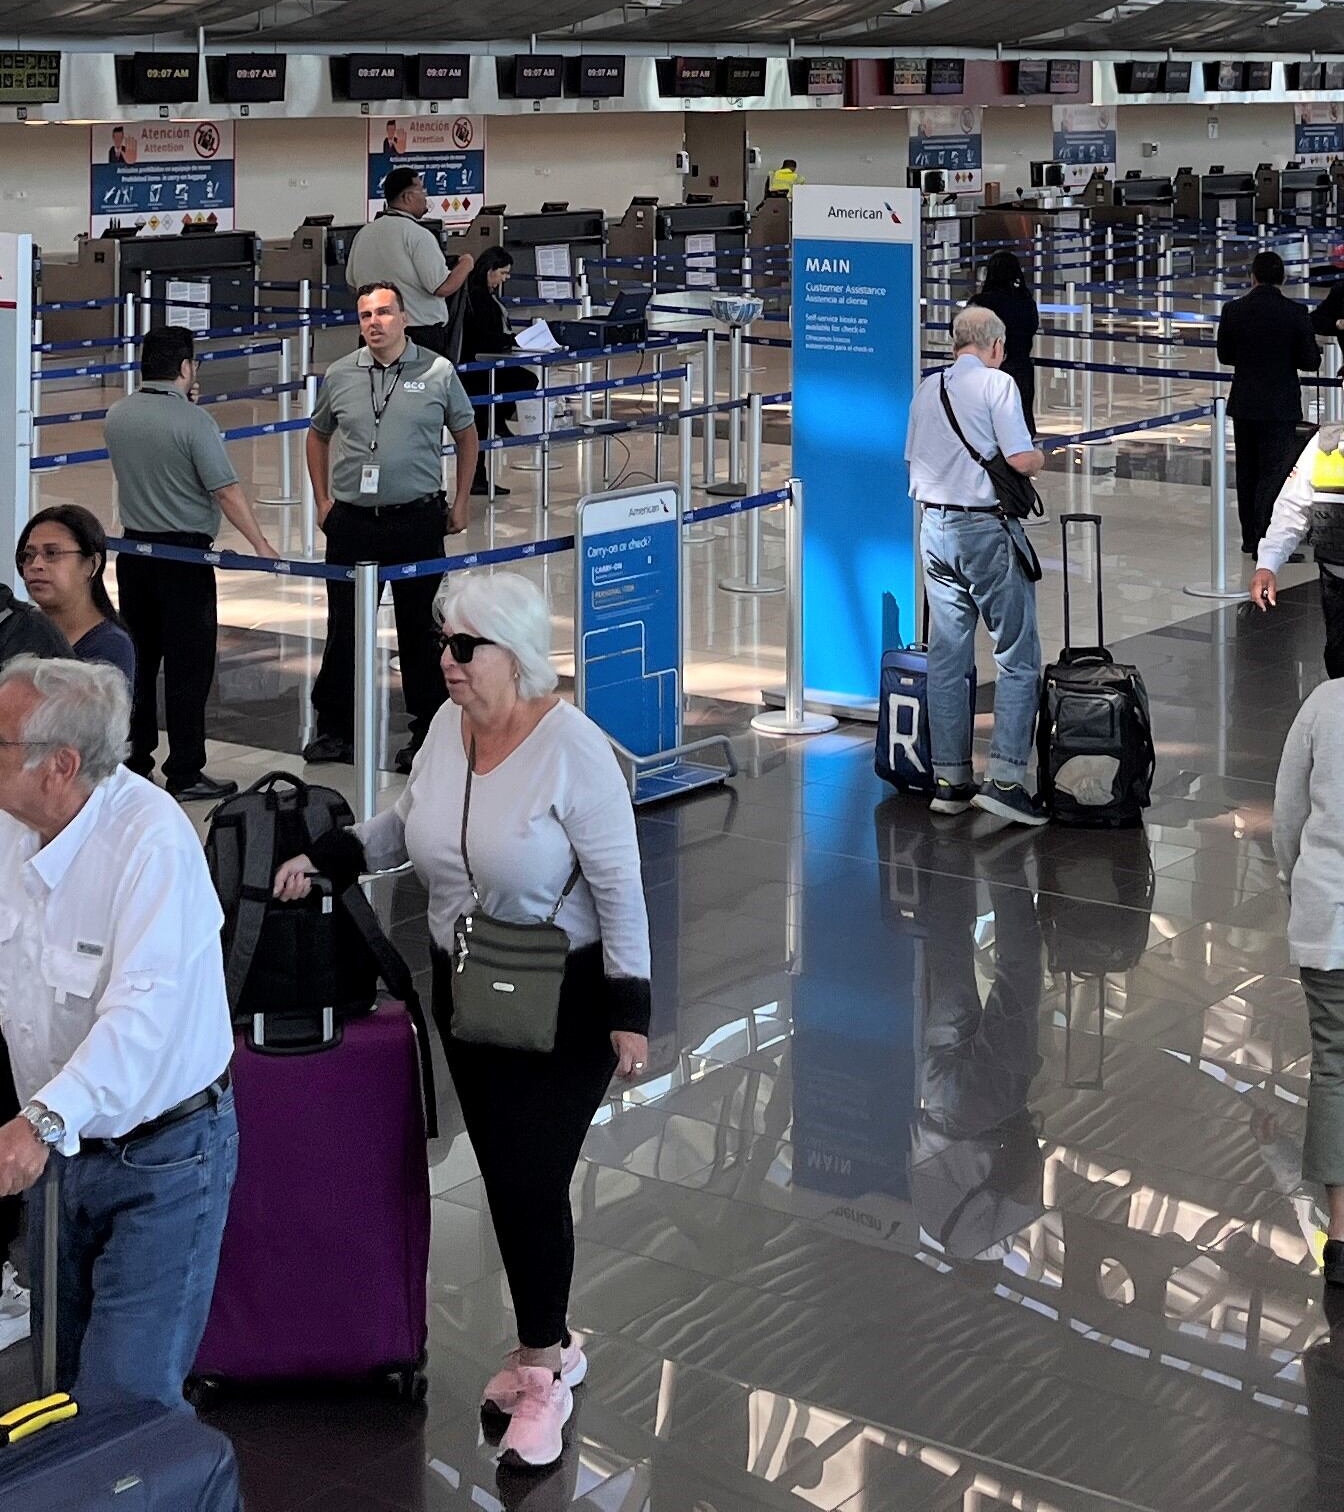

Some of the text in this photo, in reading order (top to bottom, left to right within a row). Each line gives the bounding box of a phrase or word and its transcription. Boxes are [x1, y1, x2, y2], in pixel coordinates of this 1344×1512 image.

[147, 68, 190, 78] 09:07 AM
[237, 69, 277, 79] 09:07 AM
[358, 69, 395, 77] 09:07 AM
[426, 68, 462, 77] 09:07 AM
[523, 69, 555, 77] 09:07 AM
[587, 68, 618, 77] 09:07 AM
[409, 120, 450, 131] Atención
[141, 127, 190, 139] Atención
[411, 135, 445, 144] Attention
[144, 143, 185, 153] Attention
[827, 206, 883, 220] American
[805, 257, 851, 274] MAIN
[805, 282, 887, 296] Customer Assistance
[805, 294, 837, 304] Asistencia
[628, 504, 660, 517] American
[587, 535, 652, 559] Carry-on or check?
[594, 562, 623, 574] CARRY-ON
[889, 692, 927, 774] R
